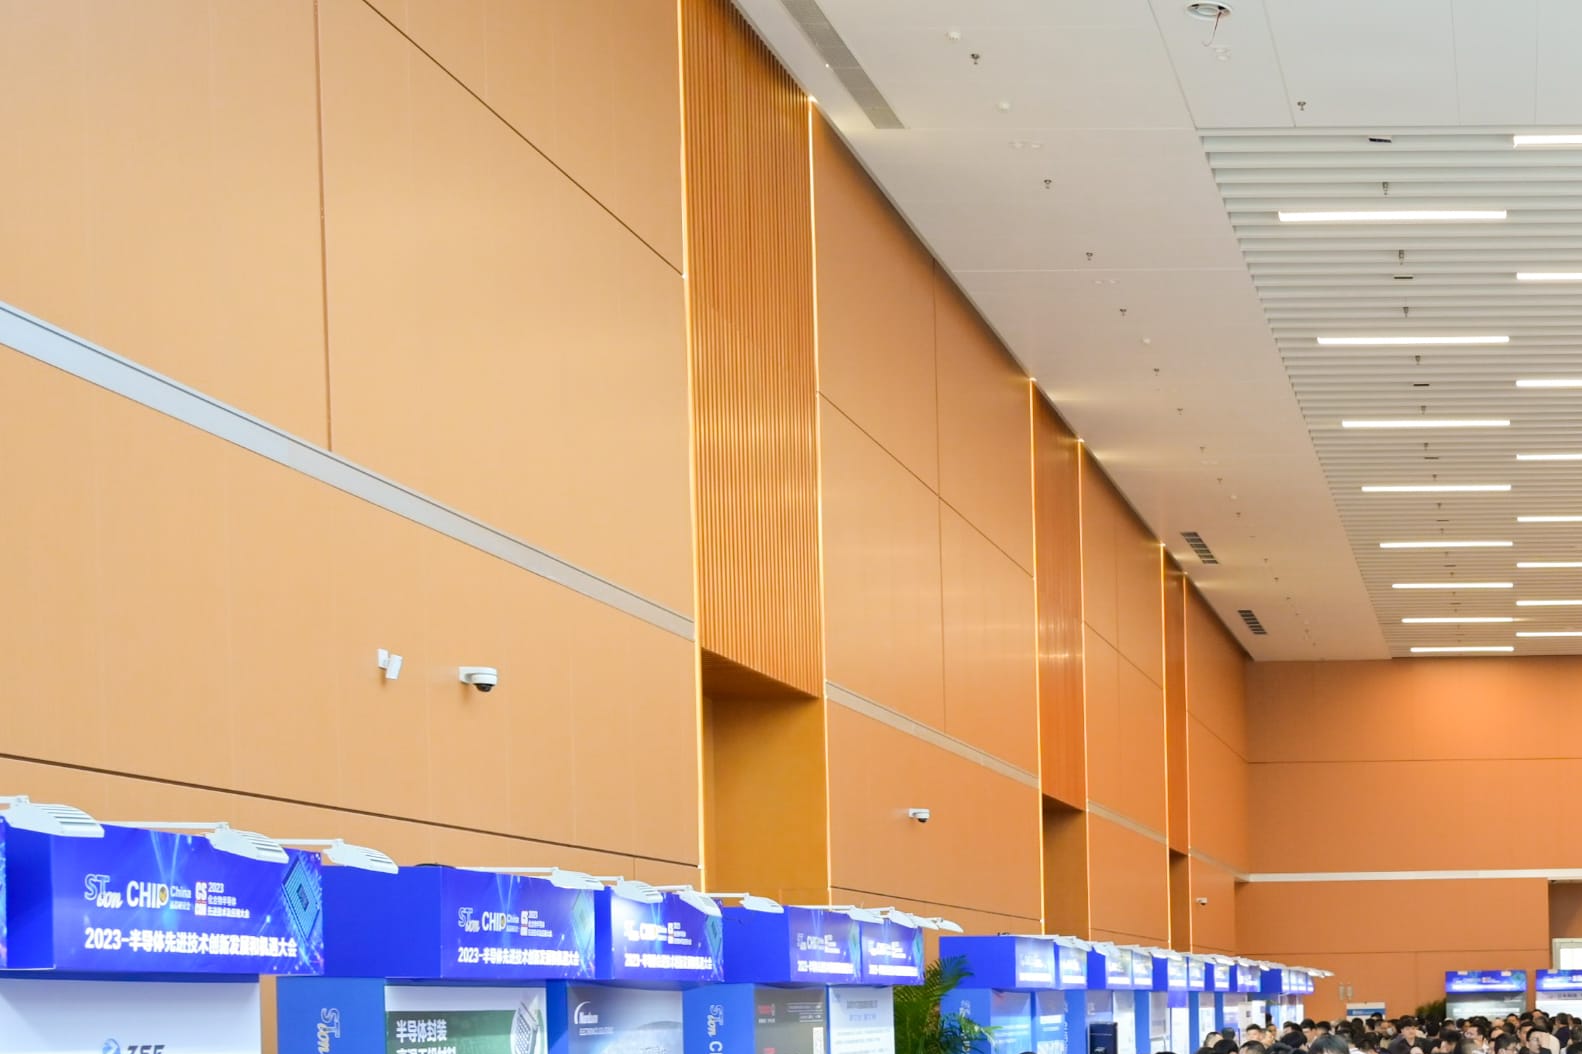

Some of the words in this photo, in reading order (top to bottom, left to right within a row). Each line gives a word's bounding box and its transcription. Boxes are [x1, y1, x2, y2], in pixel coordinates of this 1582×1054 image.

[126, 880, 169, 908] CHIP
[396, 1019, 447, 1043] 半导体封装
